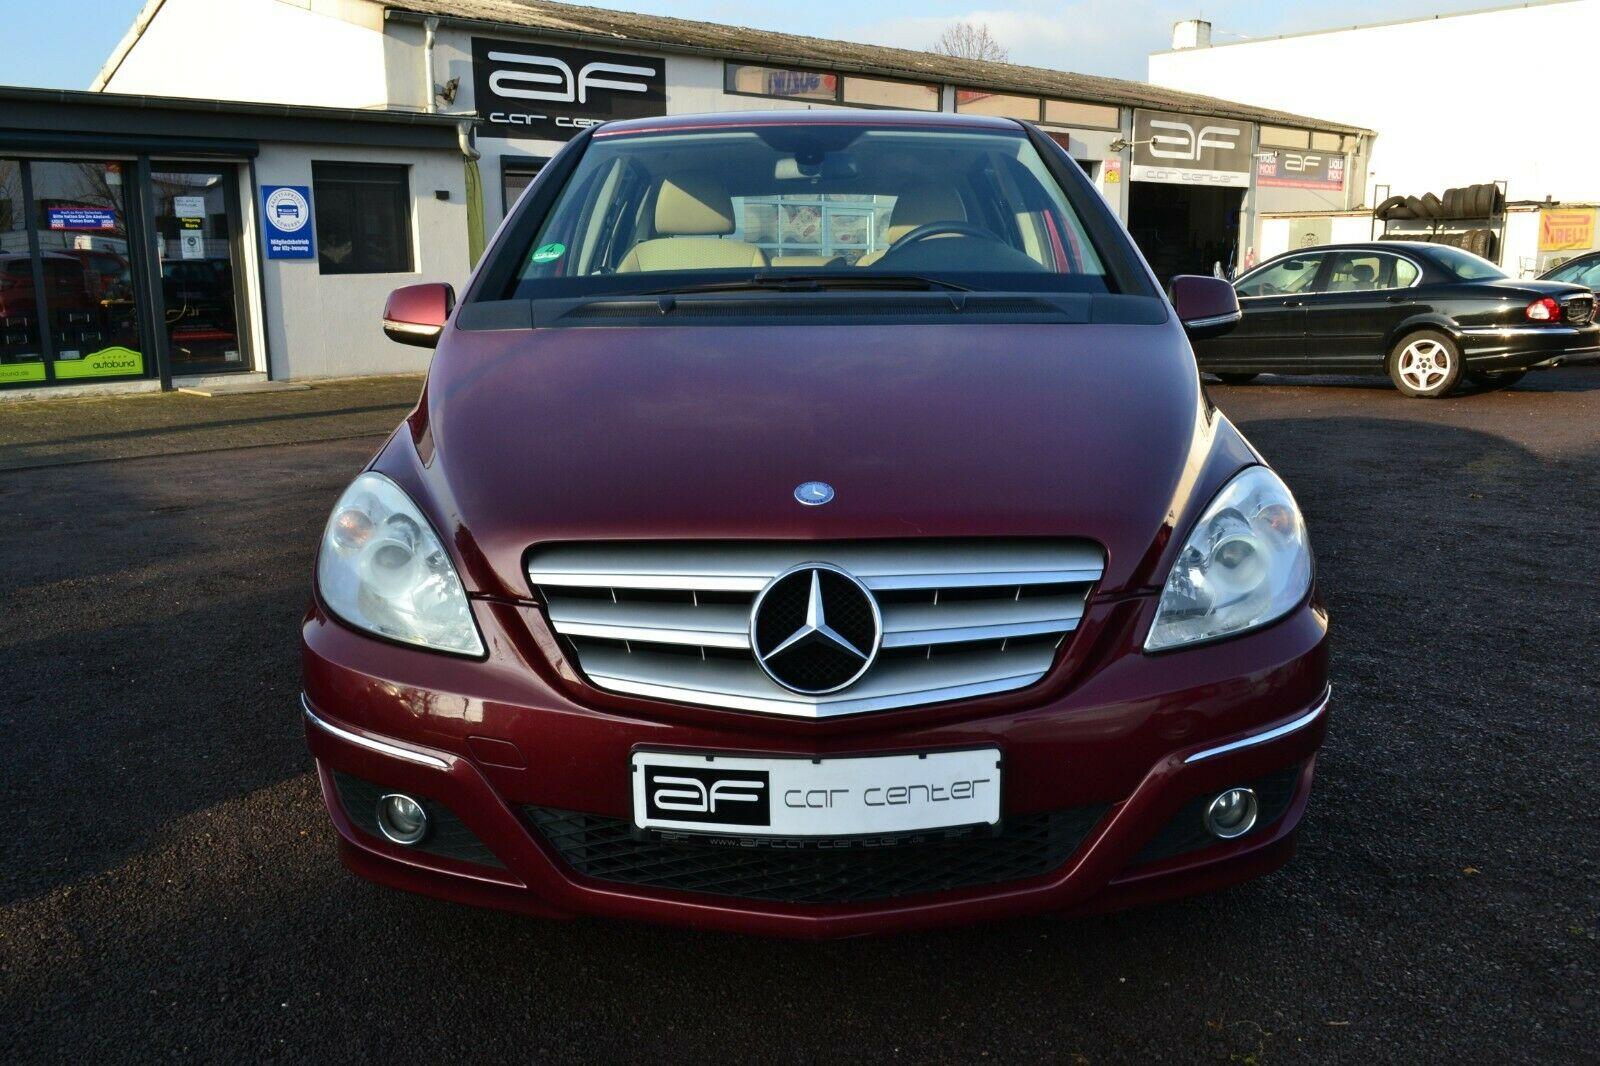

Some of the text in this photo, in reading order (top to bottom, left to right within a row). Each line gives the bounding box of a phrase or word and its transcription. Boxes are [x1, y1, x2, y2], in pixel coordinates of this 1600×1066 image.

[489, 112, 548, 125] car
[1146, 170, 1240, 183] car center
[93, 360, 136, 369] autobund
[783, 778, 991, 809] car center
[709, 832, 926, 850] www.afcarcenter.de
